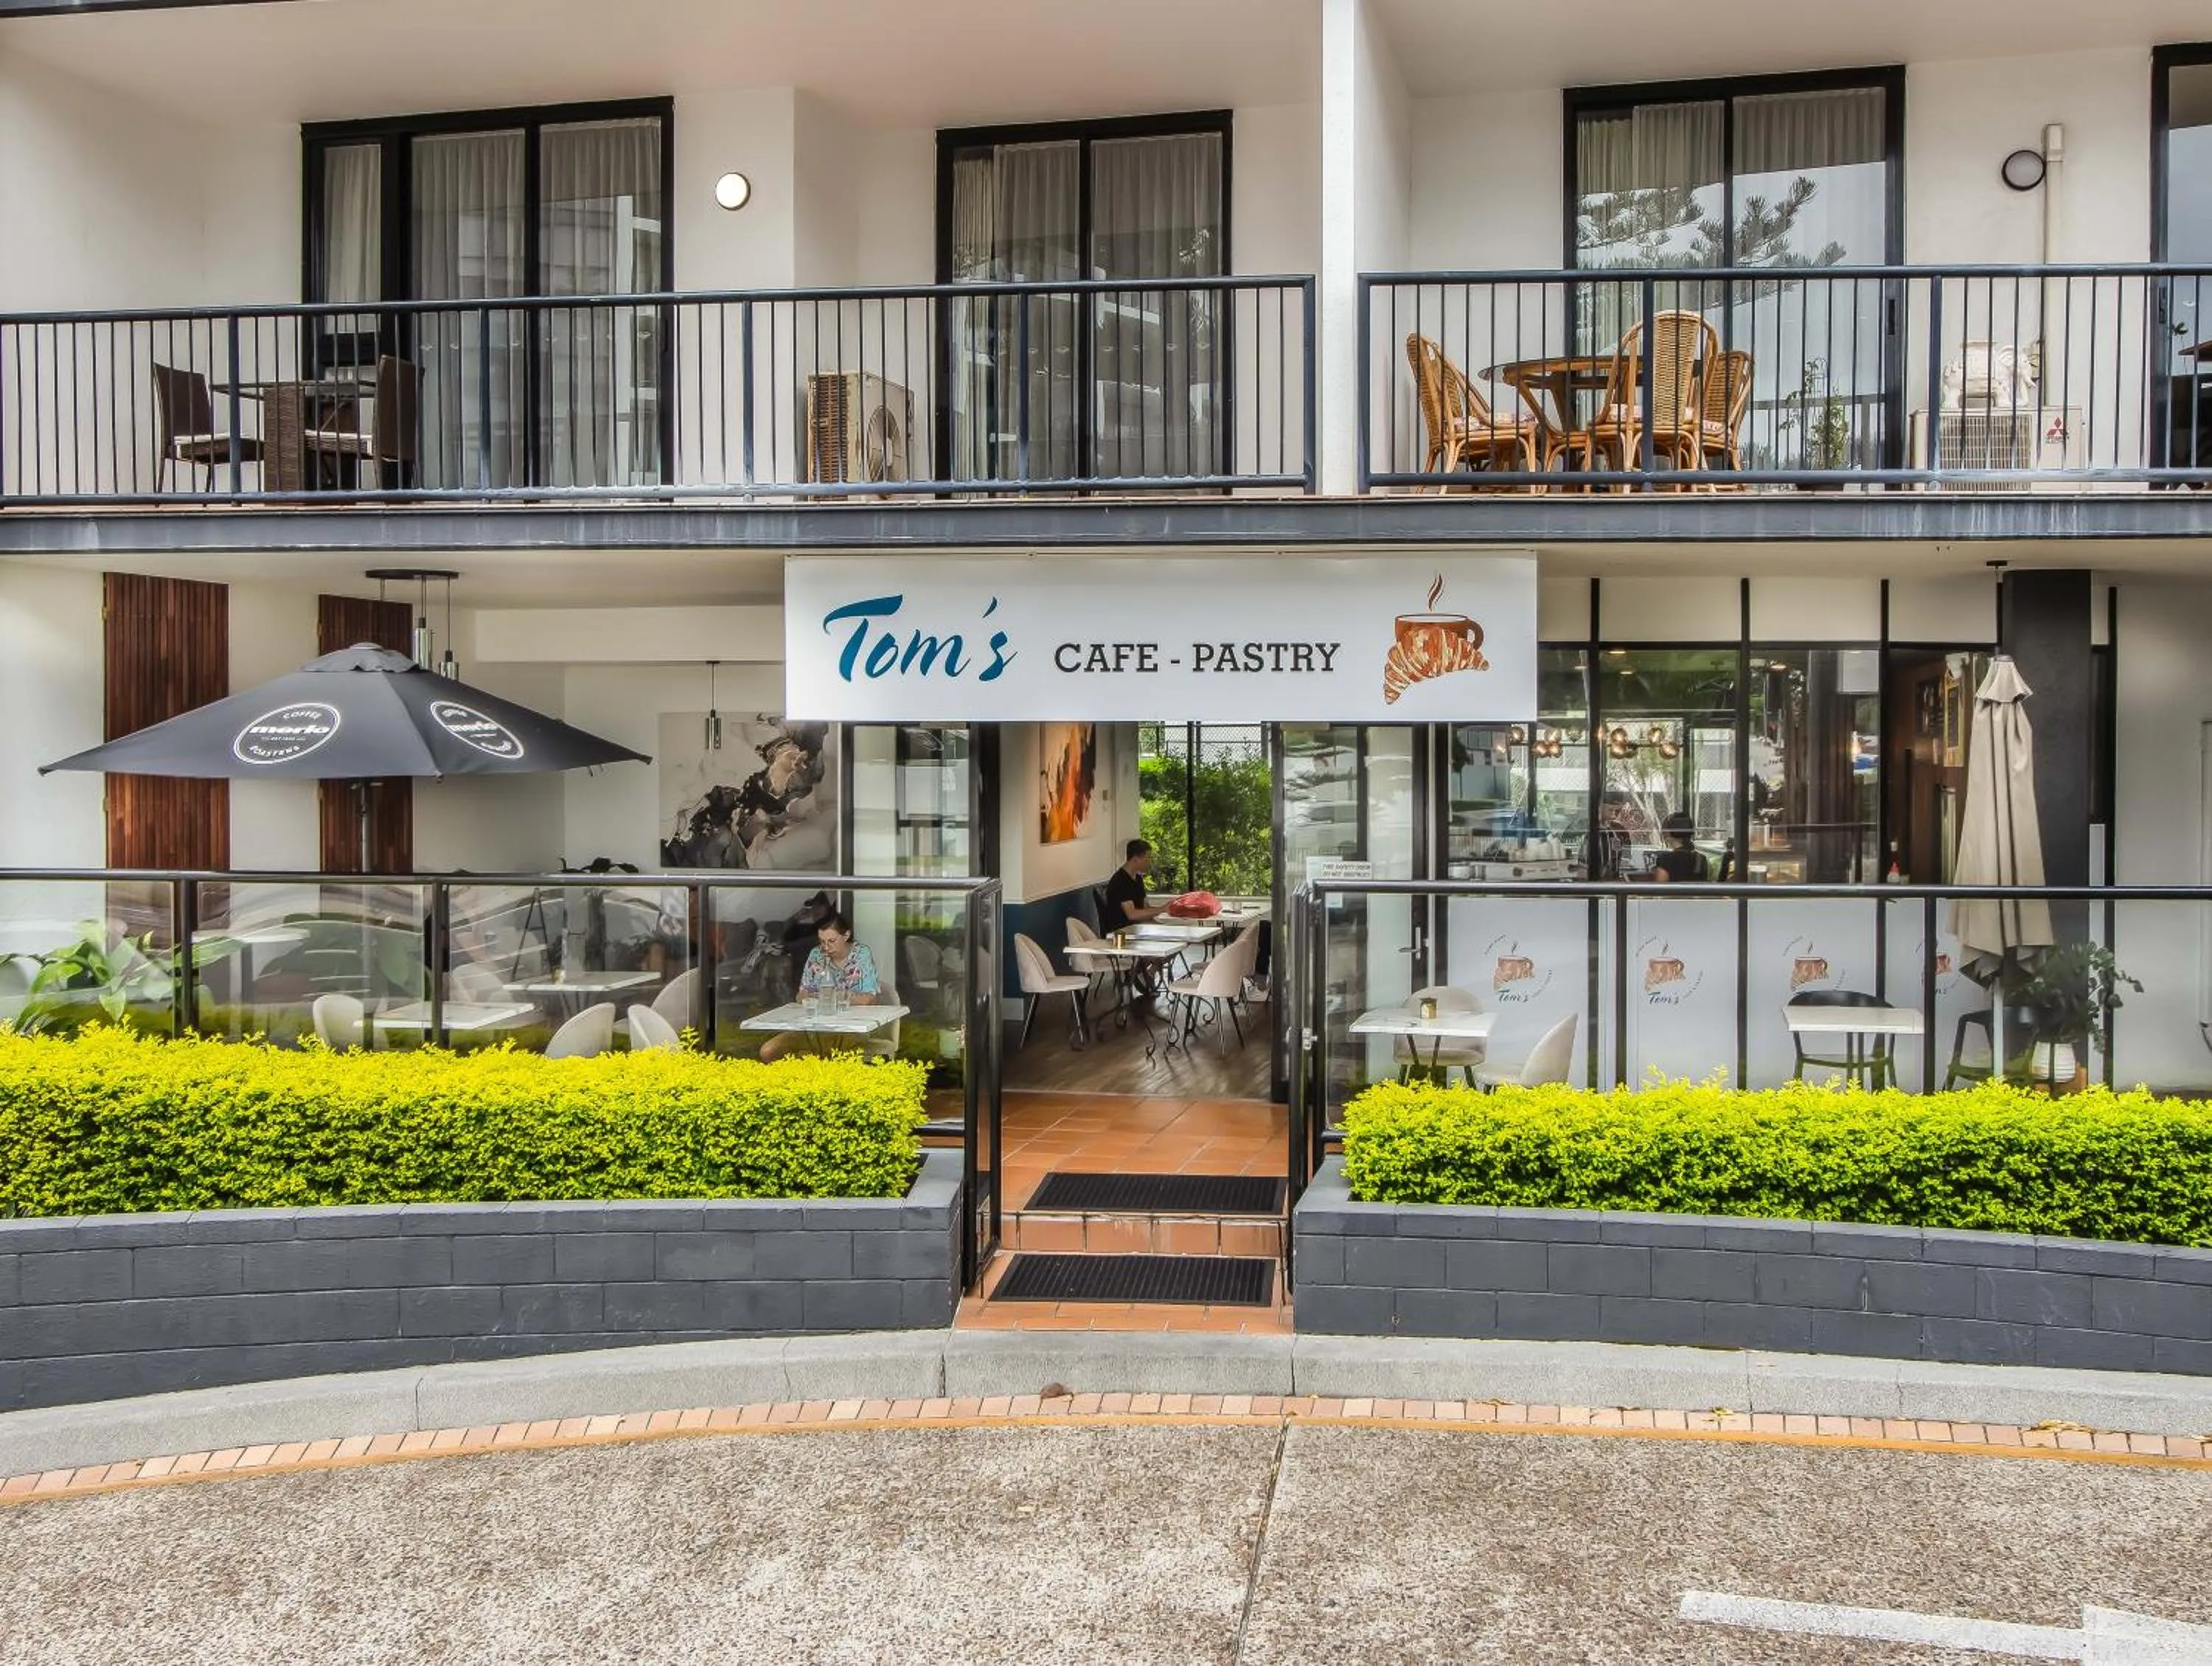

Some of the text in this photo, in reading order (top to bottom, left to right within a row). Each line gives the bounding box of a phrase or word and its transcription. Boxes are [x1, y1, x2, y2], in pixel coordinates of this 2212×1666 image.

[823, 593, 1018, 683] Tom's
[1054, 642, 1158, 673] CAFE
[1192, 642, 1340, 673] PASTRY
[1498, 988, 1528, 1003] Tom's
[1648, 991, 1679, 1005] Tom's
